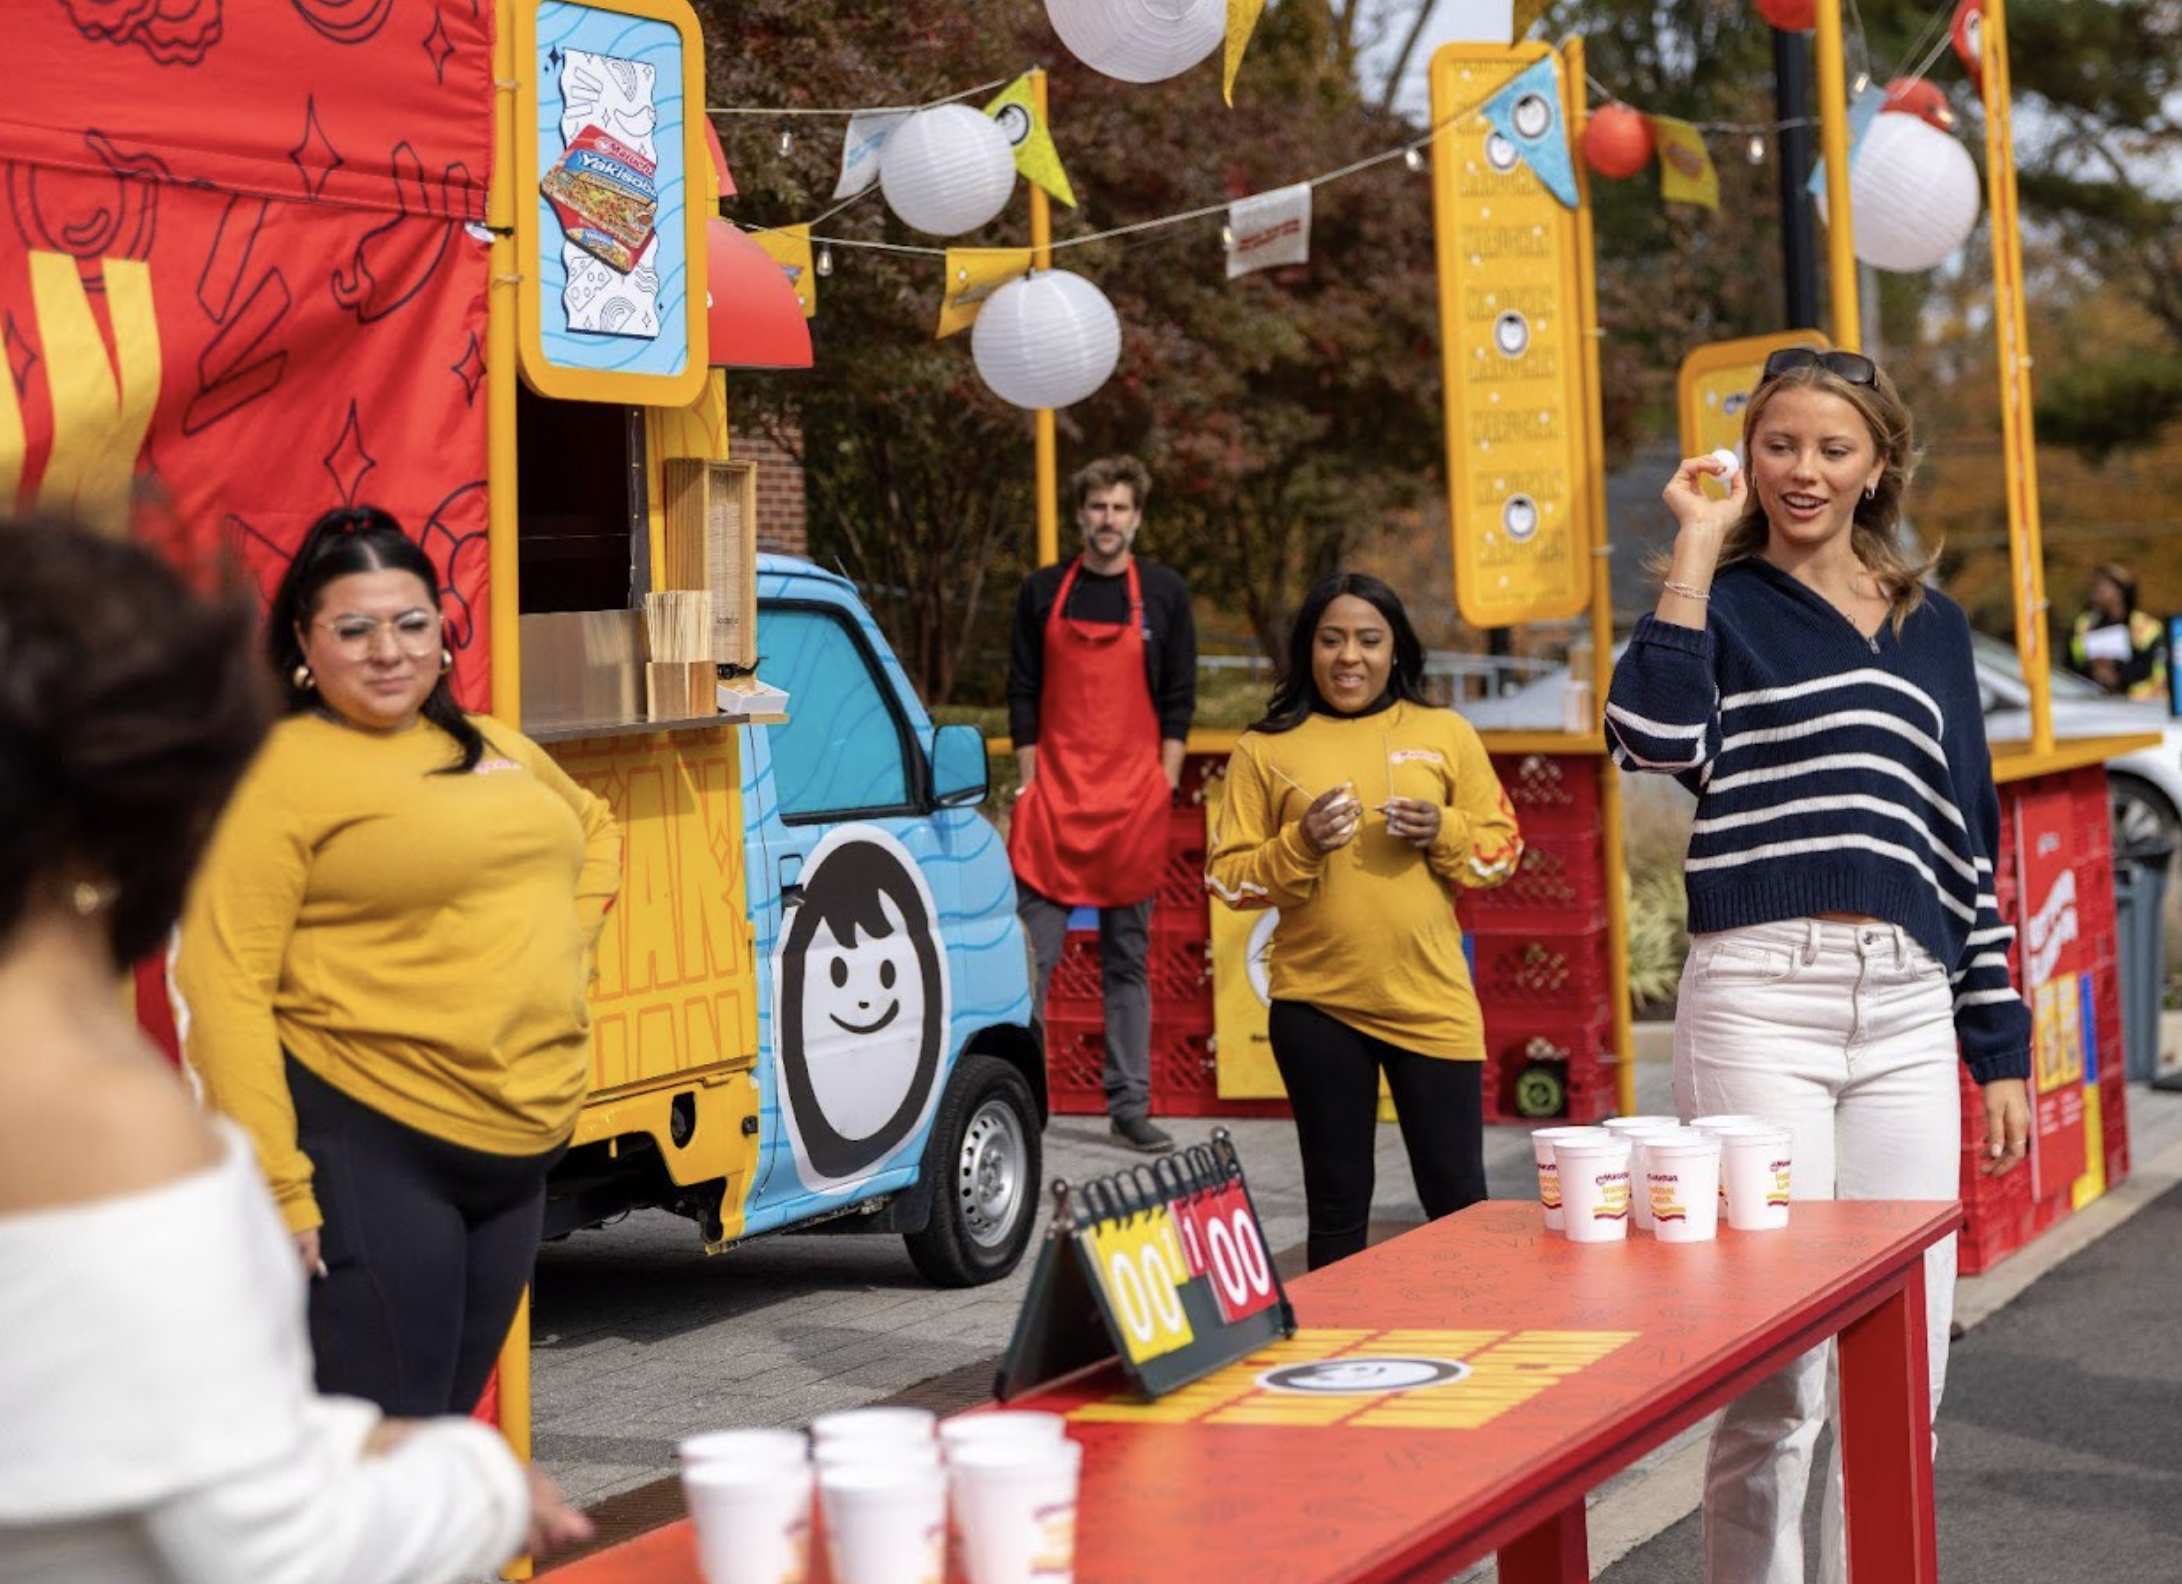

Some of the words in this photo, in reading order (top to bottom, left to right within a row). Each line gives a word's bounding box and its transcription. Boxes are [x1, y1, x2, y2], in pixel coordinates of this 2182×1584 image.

[1110, 1242, 1182, 1342] 00
[1161, 1226, 1182, 1276] 1
[1183, 1216, 1204, 1270] 1
[1206, 1207, 1271, 1306] 00
